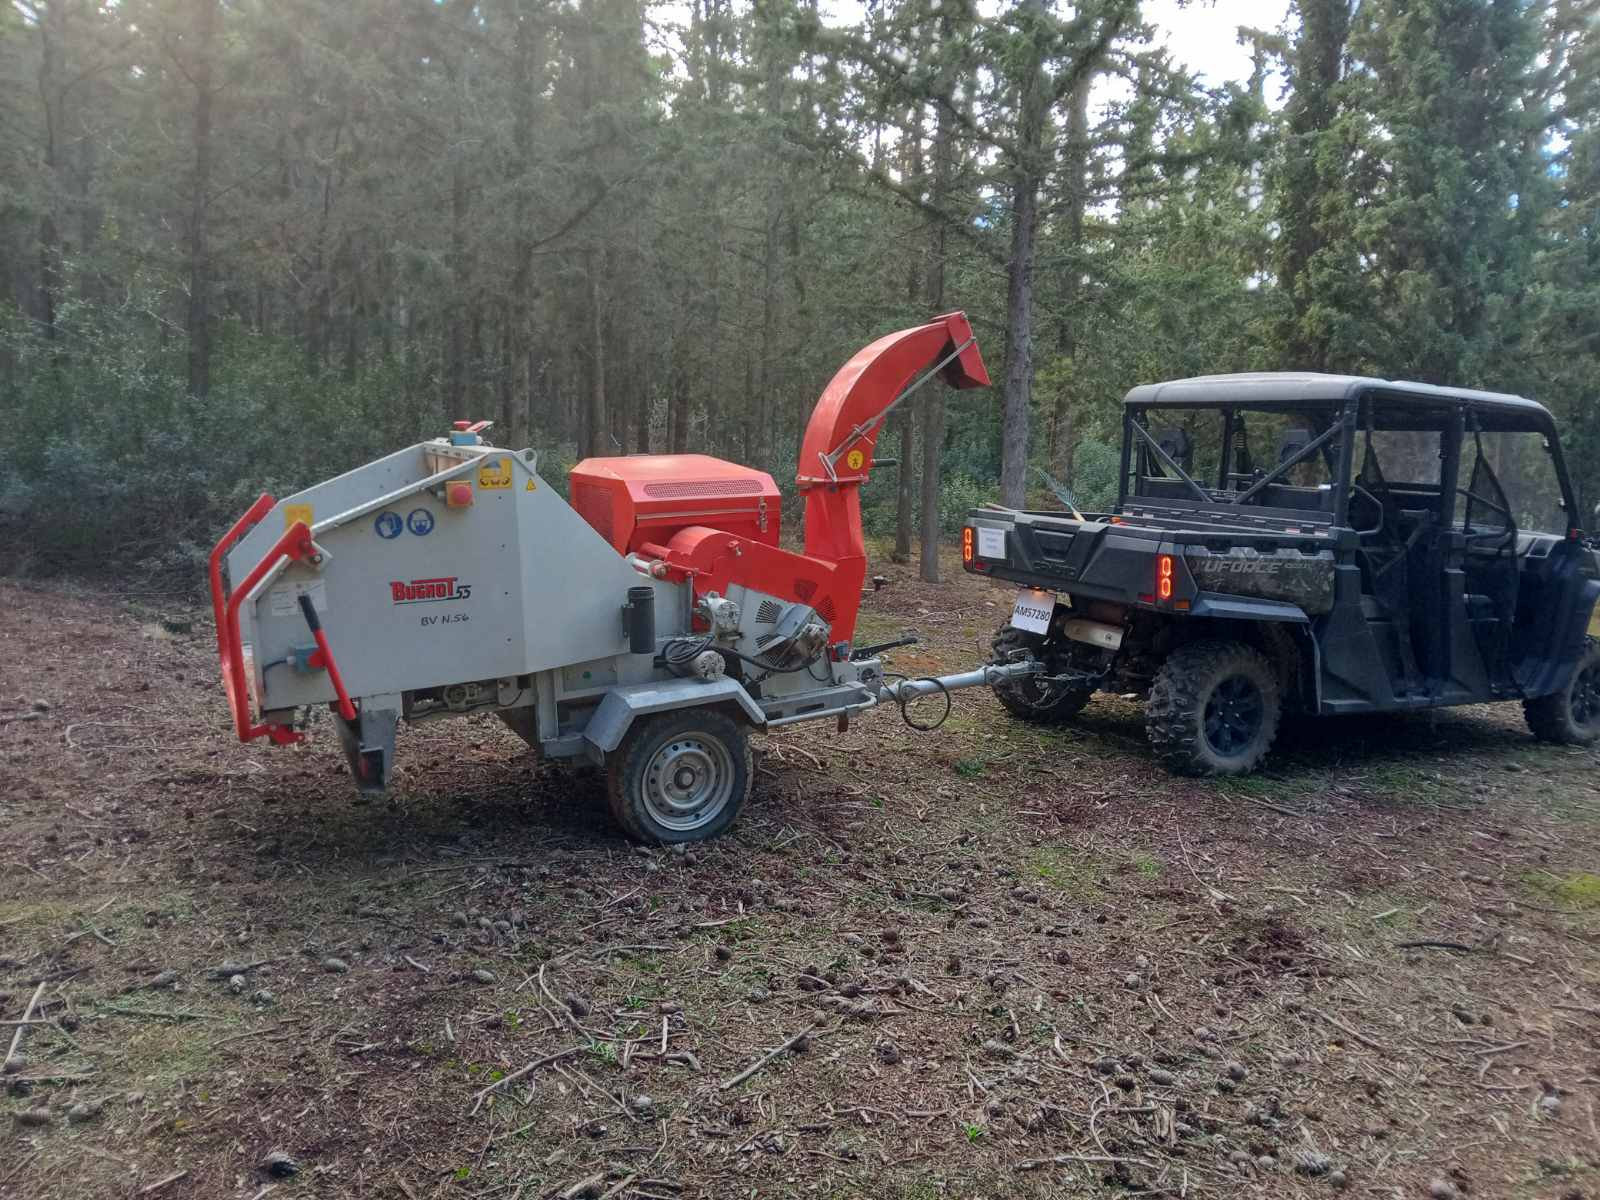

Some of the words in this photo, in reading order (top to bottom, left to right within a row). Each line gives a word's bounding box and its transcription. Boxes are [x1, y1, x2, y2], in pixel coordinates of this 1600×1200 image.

[1203, 560, 1281, 574] UFORCE
[456, 584, 472, 600] 55
[420, 615, 438, 626] BV
[1014, 605, 1051, 622] AM57280
